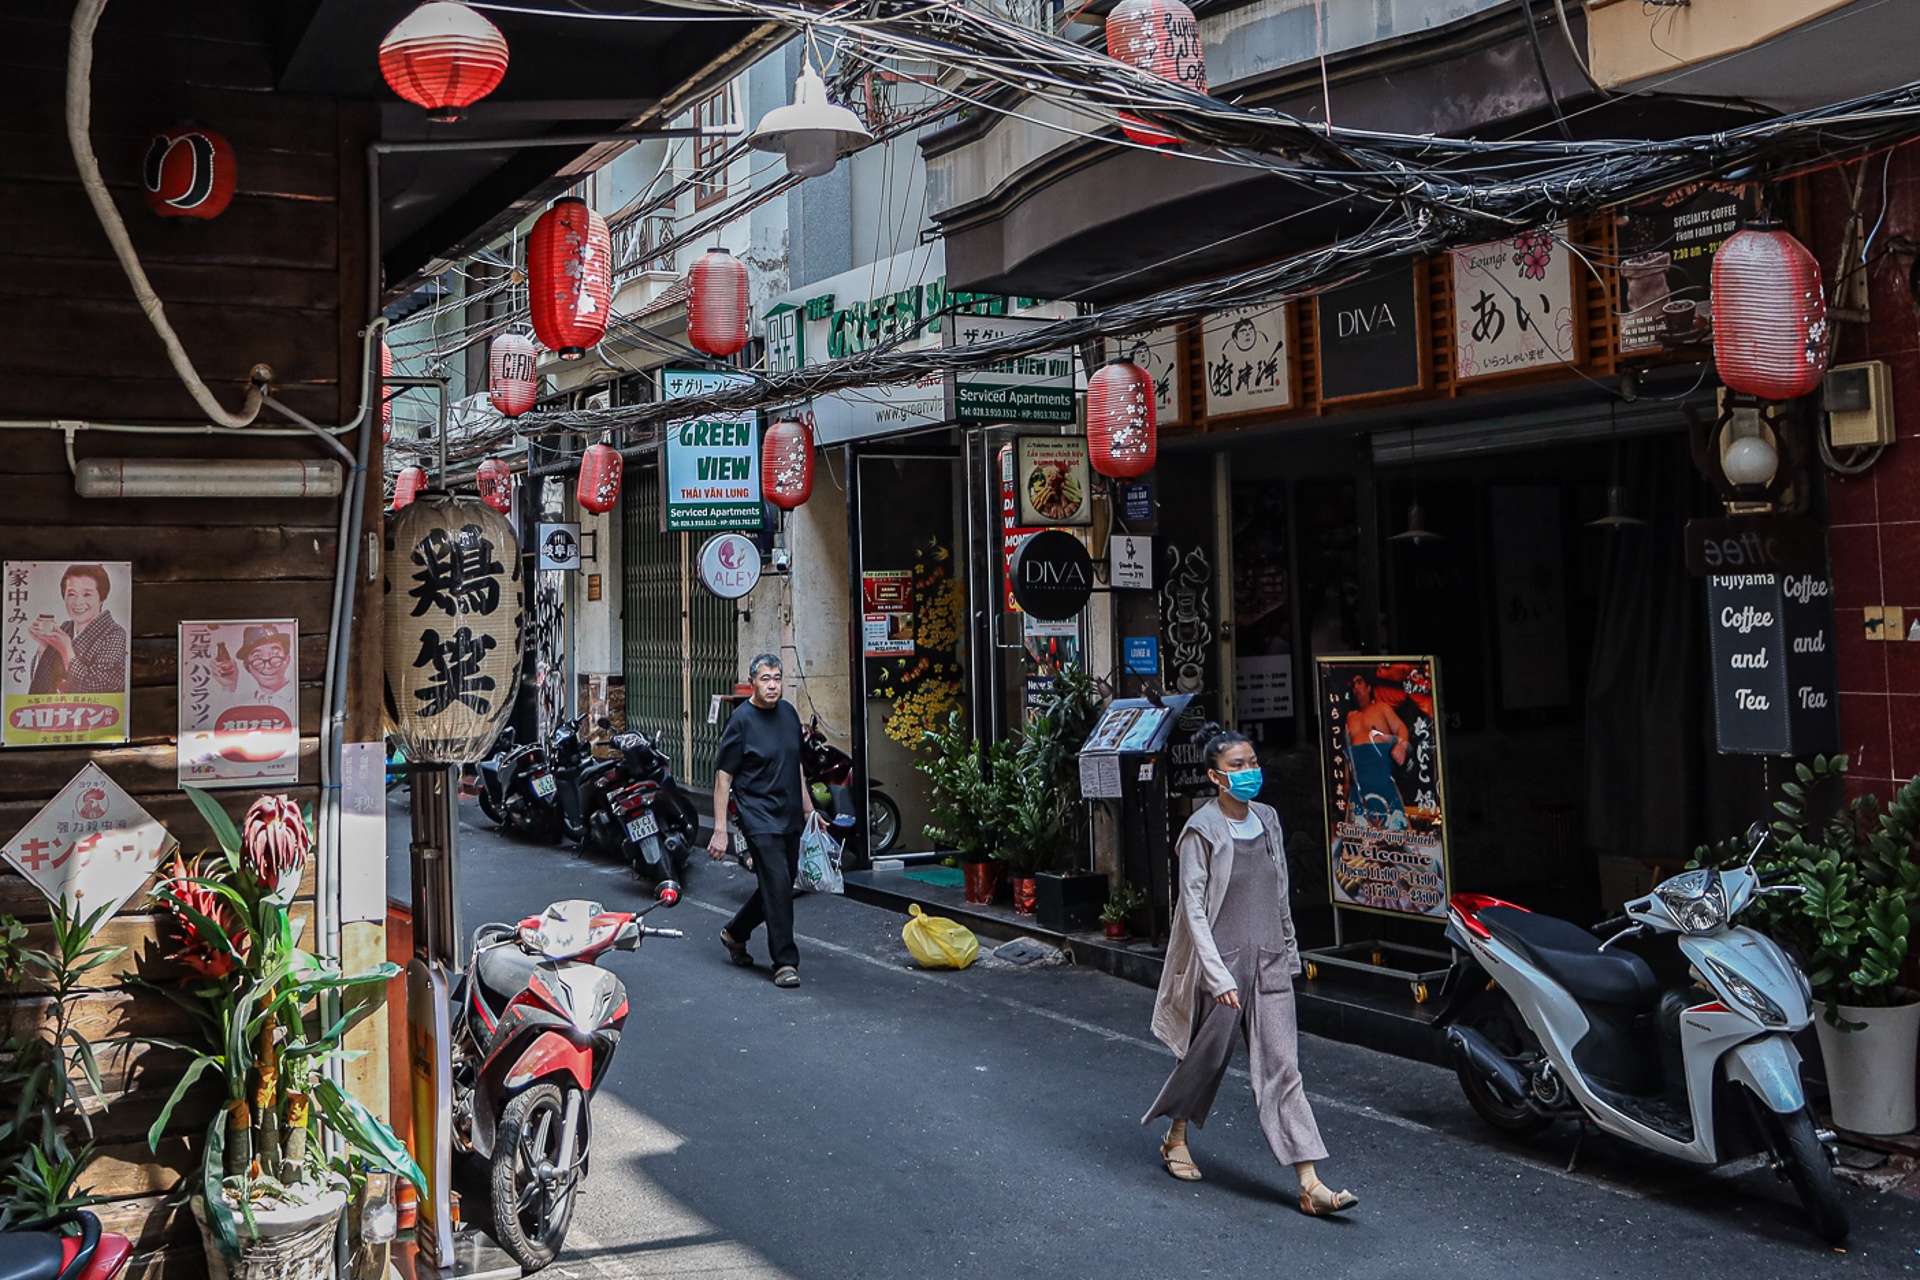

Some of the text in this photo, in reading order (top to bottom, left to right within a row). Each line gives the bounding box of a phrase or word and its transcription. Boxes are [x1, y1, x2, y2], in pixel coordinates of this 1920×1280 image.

[1673, 204, 1738, 229] SPECIALTY COFFEE
[1470, 252, 1507, 270] Lounge
[806, 293, 835, 322] THE
[1470, 289, 1551, 344] あい
[1338, 303, 1396, 338] DIVA
[1017, 357, 1046, 376] VIEW
[1483, 348, 1545, 368] いらっしゃいませ
[959, 388, 1071, 406] Serviced Apartments
[680, 422, 751, 446] GREEN
[697, 455, 751, 481] VIEW
[680, 486, 702, 498] THÁI
[726, 487, 749, 498] LUNG
[670, 506, 760, 518] Serviced Apartments
[713, 571, 757, 587] ALEY
[1026, 560, 1086, 585] DIVA
[1783, 575, 1828, 603] Coffee
[7, 568, 29, 683] 家中みんなで
[1721, 607, 1774, 633] Coffee
[1793, 630, 1825, 653] and
[1731, 647, 1768, 669] and
[1735, 688, 1770, 711] Tea
[1798, 686, 1828, 709] Tea
[16, 707, 105, 728] オロナイン
[222, 718, 286, 731] オロナミン
[1329, 692, 1346, 811] いらっしゃいませ
[1343, 842, 1431, 866] Welcome
[1369, 867, 1397, 880] 11:00
